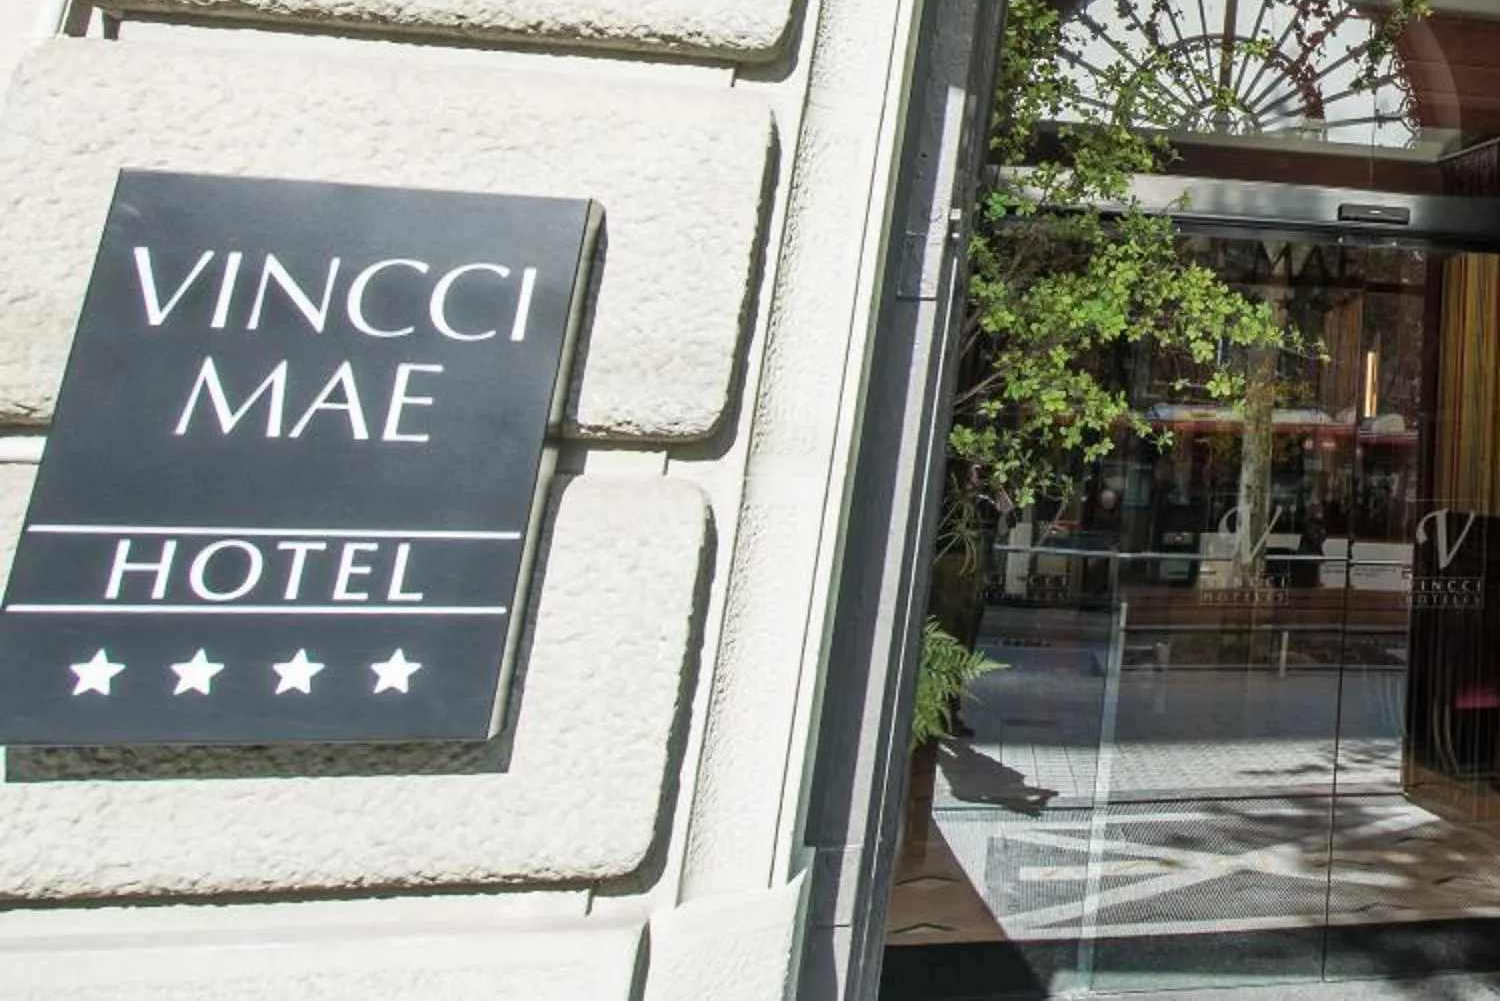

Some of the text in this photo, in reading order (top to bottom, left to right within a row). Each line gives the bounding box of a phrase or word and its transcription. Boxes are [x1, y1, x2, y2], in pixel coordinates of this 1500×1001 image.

[133, 246, 537, 341] VINCCI
[174, 355, 444, 442] MAE
[104, 539, 424, 601] HOTEL
[1415, 508, 1476, 570] V
